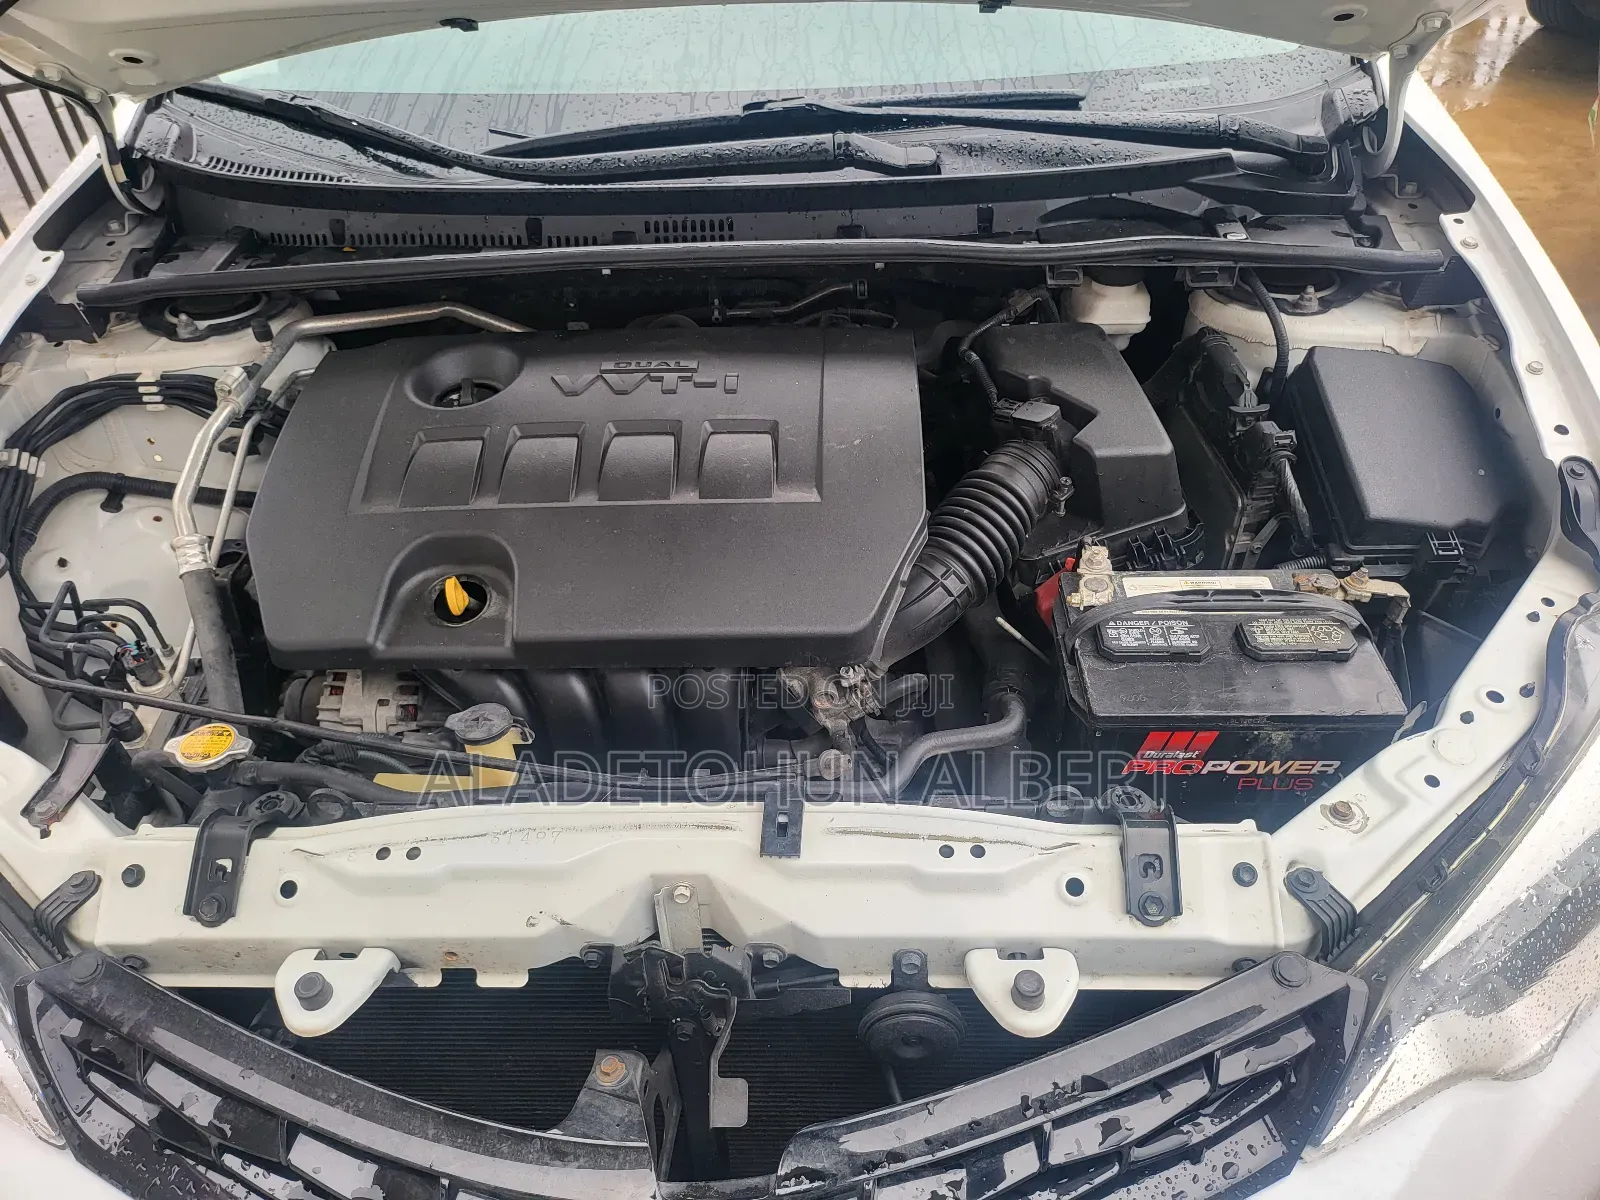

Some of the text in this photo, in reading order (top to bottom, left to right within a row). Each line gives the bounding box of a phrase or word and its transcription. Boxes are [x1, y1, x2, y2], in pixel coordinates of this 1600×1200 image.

[613, 360, 690, 369] DUAL
[1143, 750, 1200, 759] Duralast
[1237, 777, 1314, 791] PLUS
